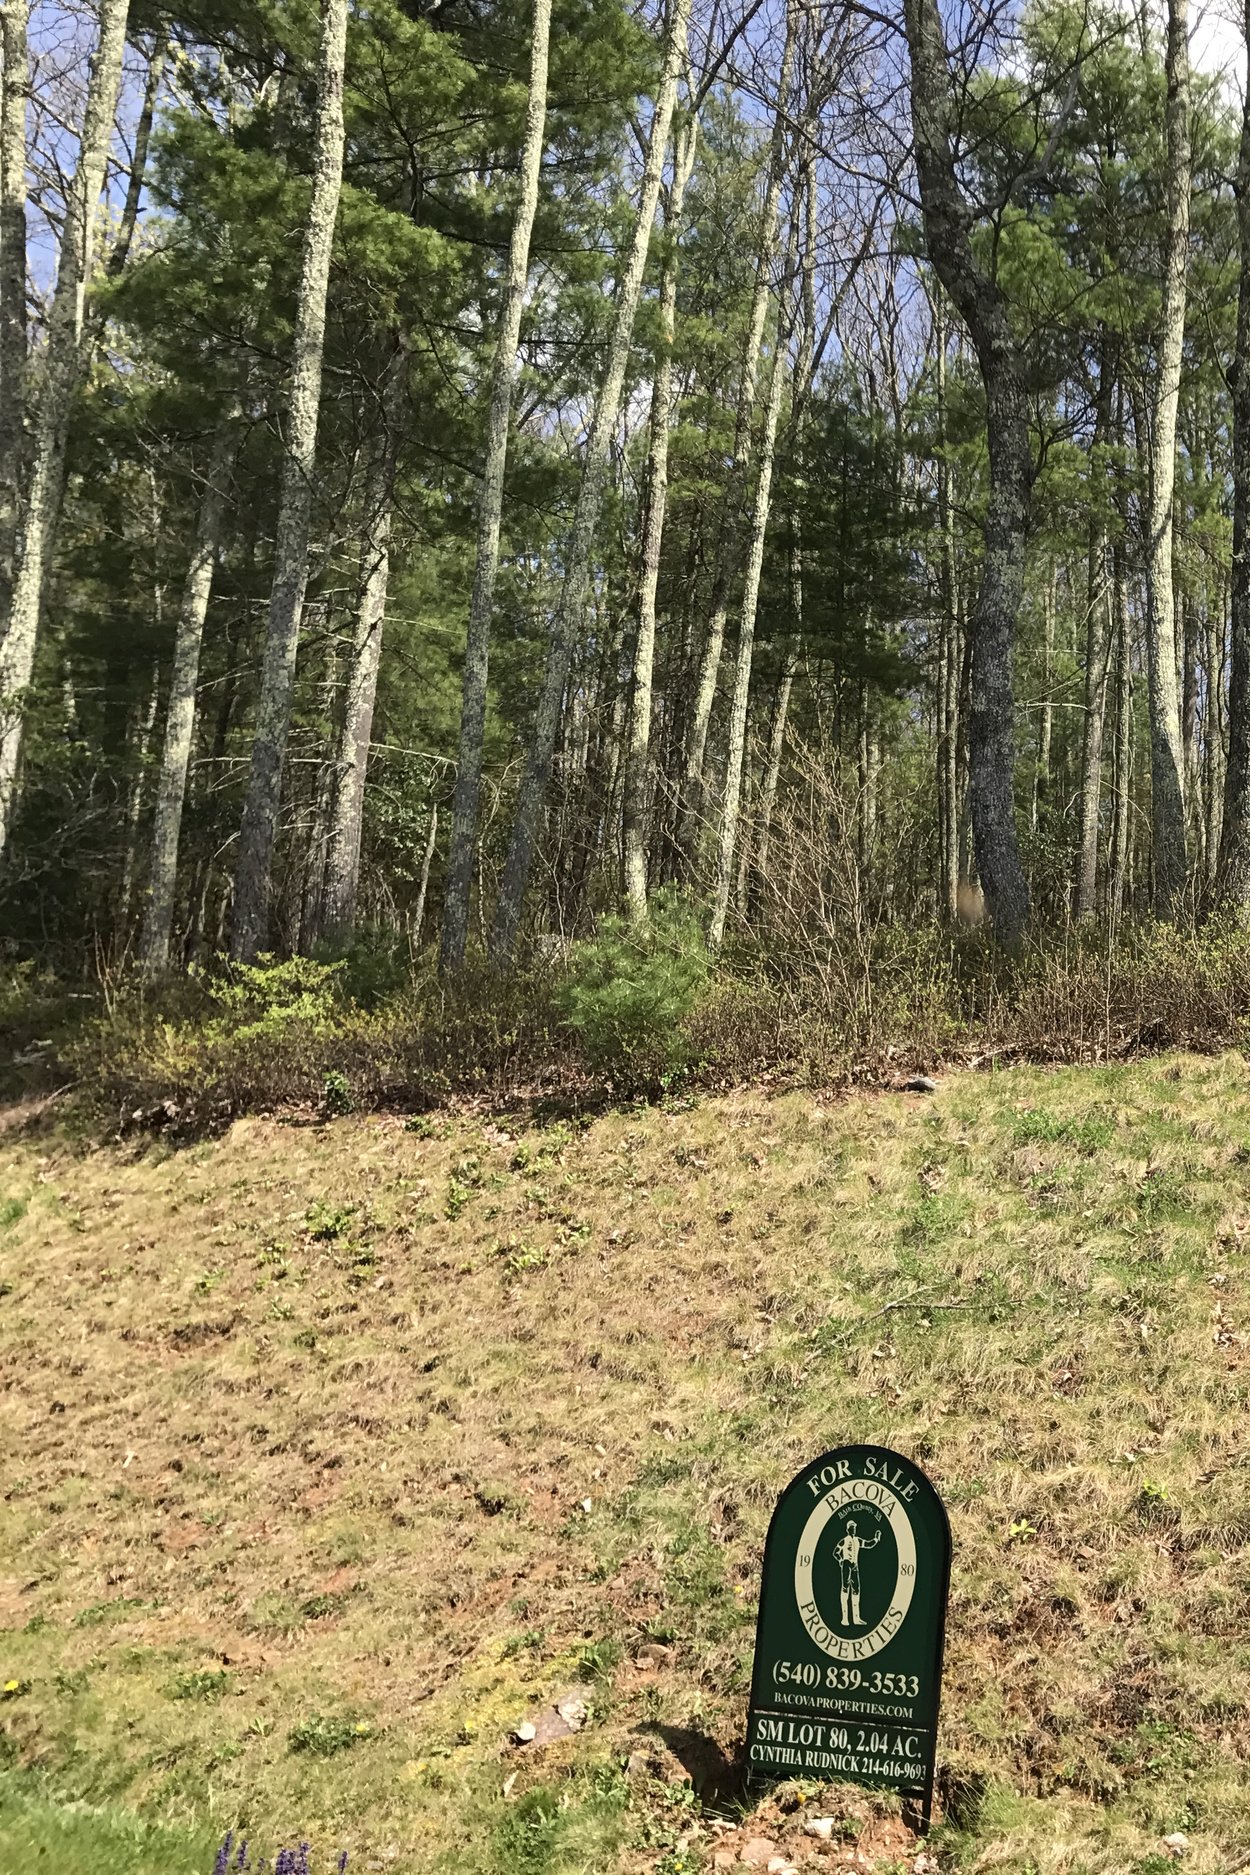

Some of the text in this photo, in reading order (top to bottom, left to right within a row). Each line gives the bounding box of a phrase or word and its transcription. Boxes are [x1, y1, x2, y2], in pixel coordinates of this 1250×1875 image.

[806, 1456, 920, 1502] FOR SALE
[825, 1482, 896, 1518] BACOVA
[799, 1555, 811, 1567] 19
[900, 1564, 914, 1576] 80
[801, 1601, 903, 1659] PROPERTIES
[773, 1660, 919, 1697] (540) 839-3533
[774, 1692, 913, 1718] BACOVAPROPERTIES.COM
[788, 1723, 826, 1746] LOT
[830, 1727, 852, 1754] 80,
[856, 1731, 888, 1754] 2.04
[891, 1735, 922, 1758] AC.
[750, 1744, 926, 1780] CYNTHIA RUDNICK 214-616-9693
